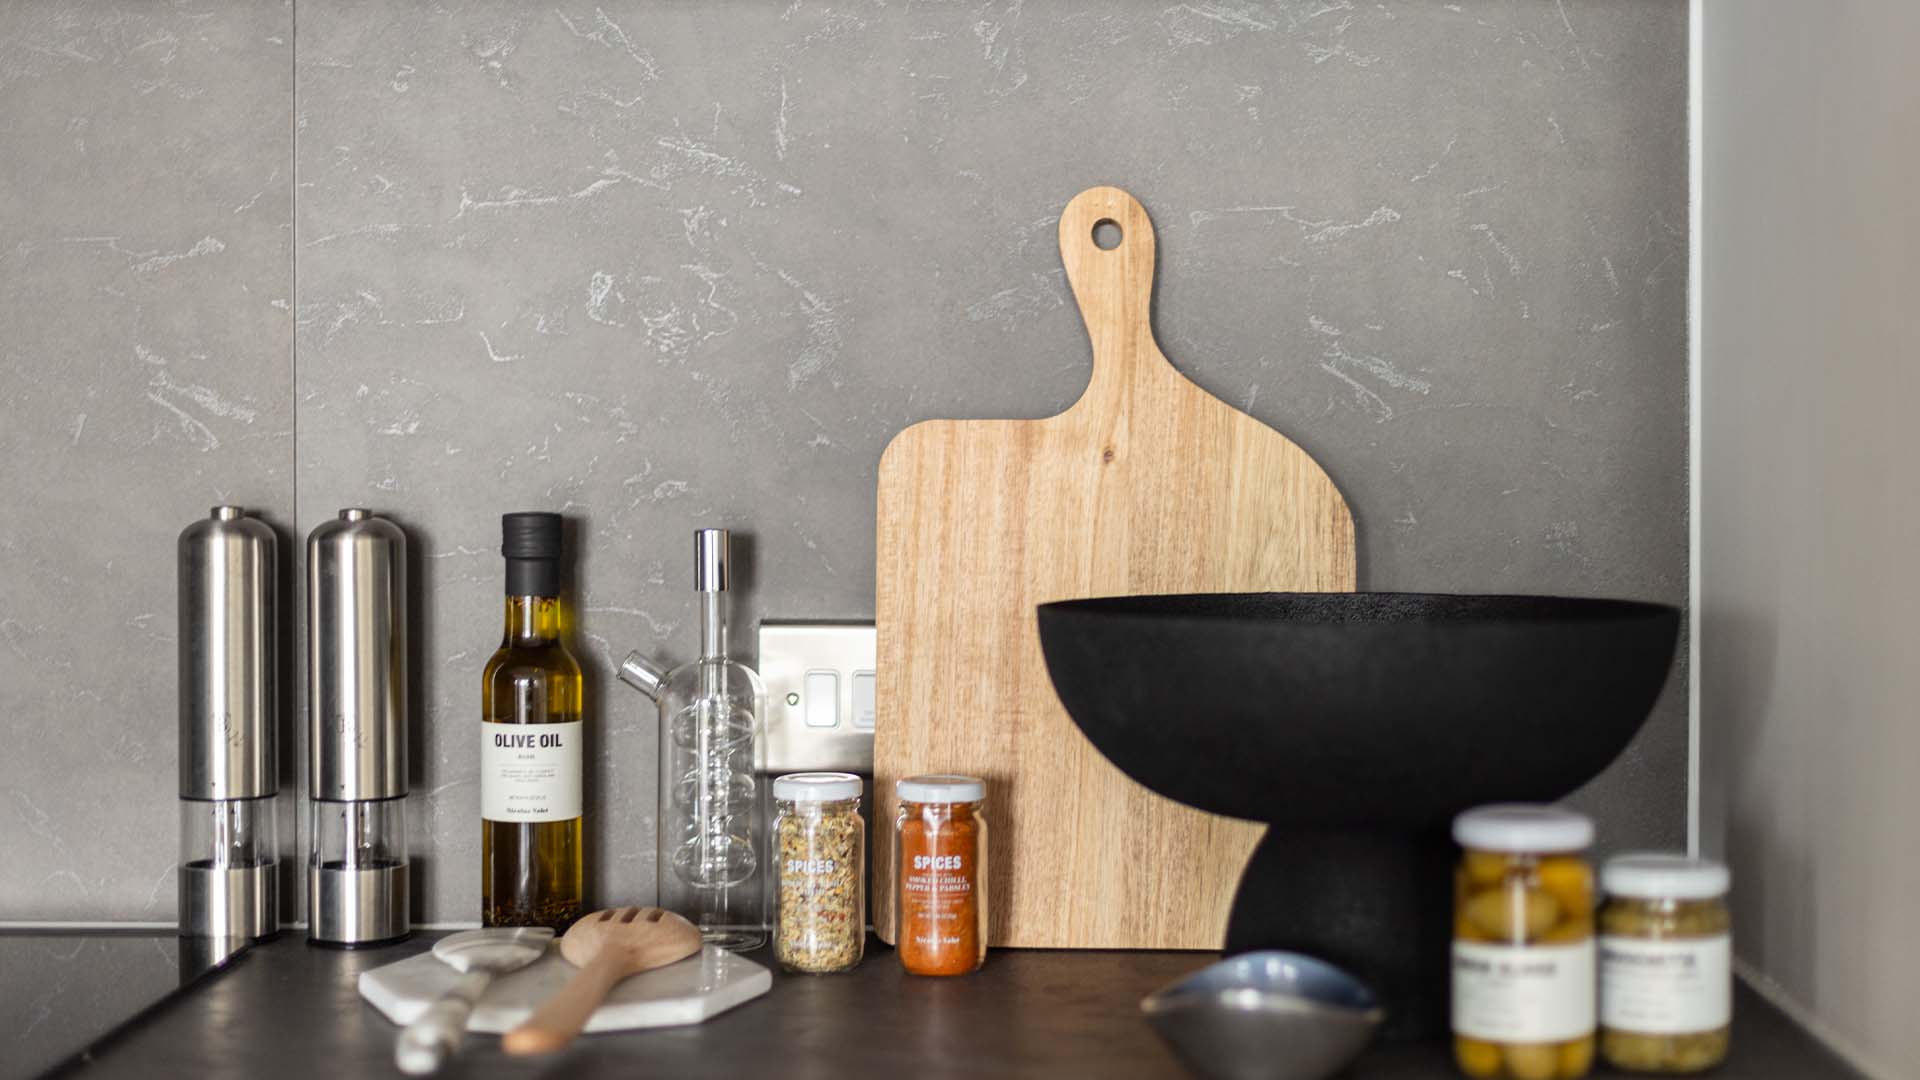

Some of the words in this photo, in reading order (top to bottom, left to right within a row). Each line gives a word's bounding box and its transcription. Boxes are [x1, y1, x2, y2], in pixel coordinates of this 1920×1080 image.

[495, 733, 536, 748] OLIVE
[540, 733, 563, 748] OIL
[787, 859, 834, 873] SPICES
[914, 855, 962, 870] SPICES
